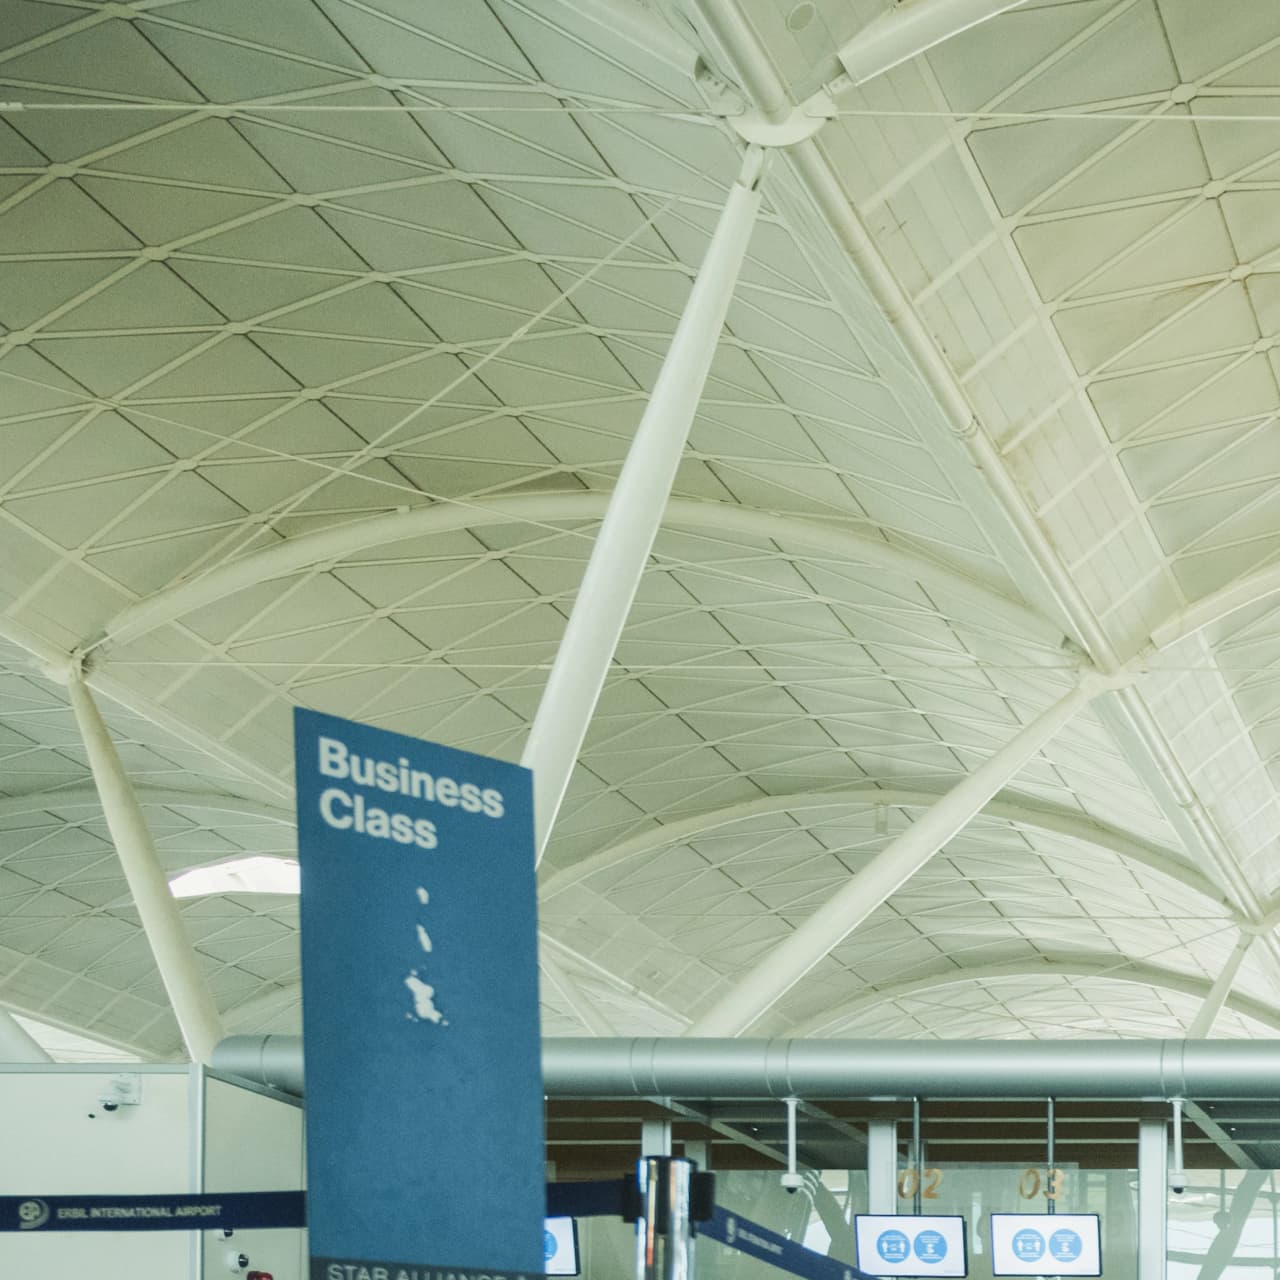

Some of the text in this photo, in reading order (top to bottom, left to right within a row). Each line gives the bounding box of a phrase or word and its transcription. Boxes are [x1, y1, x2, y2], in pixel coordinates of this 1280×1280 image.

[318, 736, 505, 819] Business
[319, 788, 439, 850] Class
[897, 1168, 943, 1200] 02
[1019, 1167, 1065, 1200] 03
[90, 1206, 173, 1219] INTERNATIONAL
[175, 1205, 223, 1217] AIRPORT
